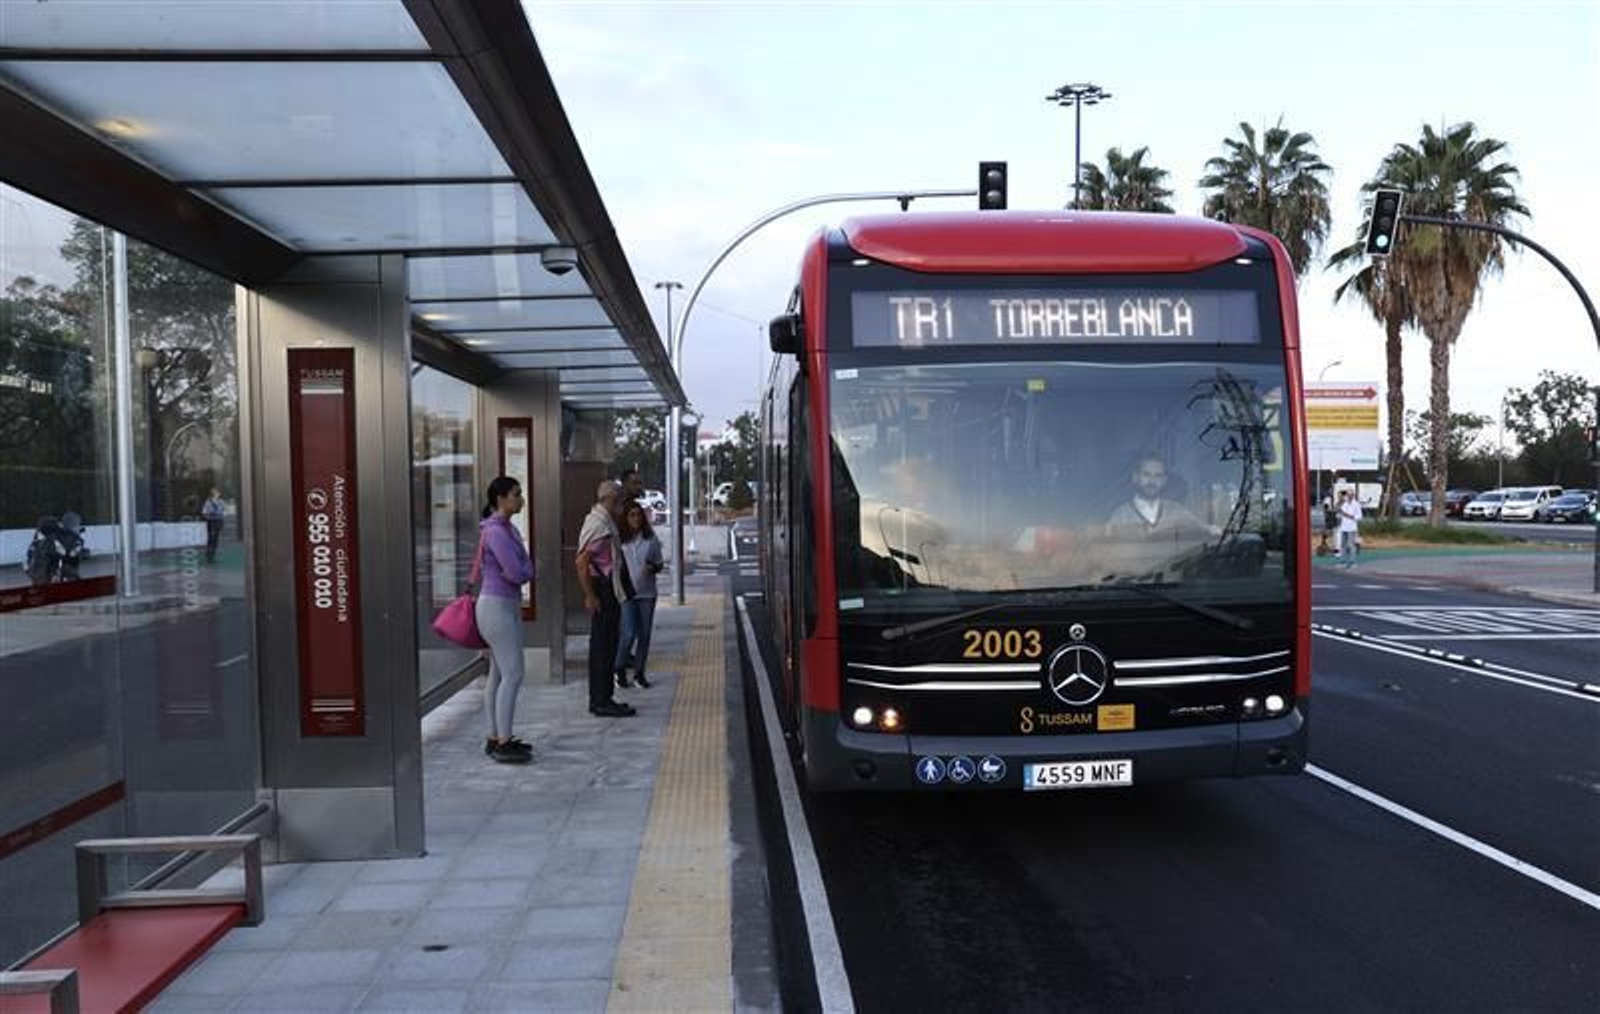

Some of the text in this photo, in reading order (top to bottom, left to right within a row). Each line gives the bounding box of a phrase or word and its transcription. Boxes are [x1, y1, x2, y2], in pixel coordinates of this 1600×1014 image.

[889, 297, 1194, 339] TR1 TORREBLANCA
[308, 513, 332, 609] 955 010 010
[334, 475, 348, 622] Atención ciudadana
[963, 630, 1042, 658] 2003
[1038, 713, 1093, 726] TUSSAM
[1037, 763, 1127, 784] 4559 MNF
